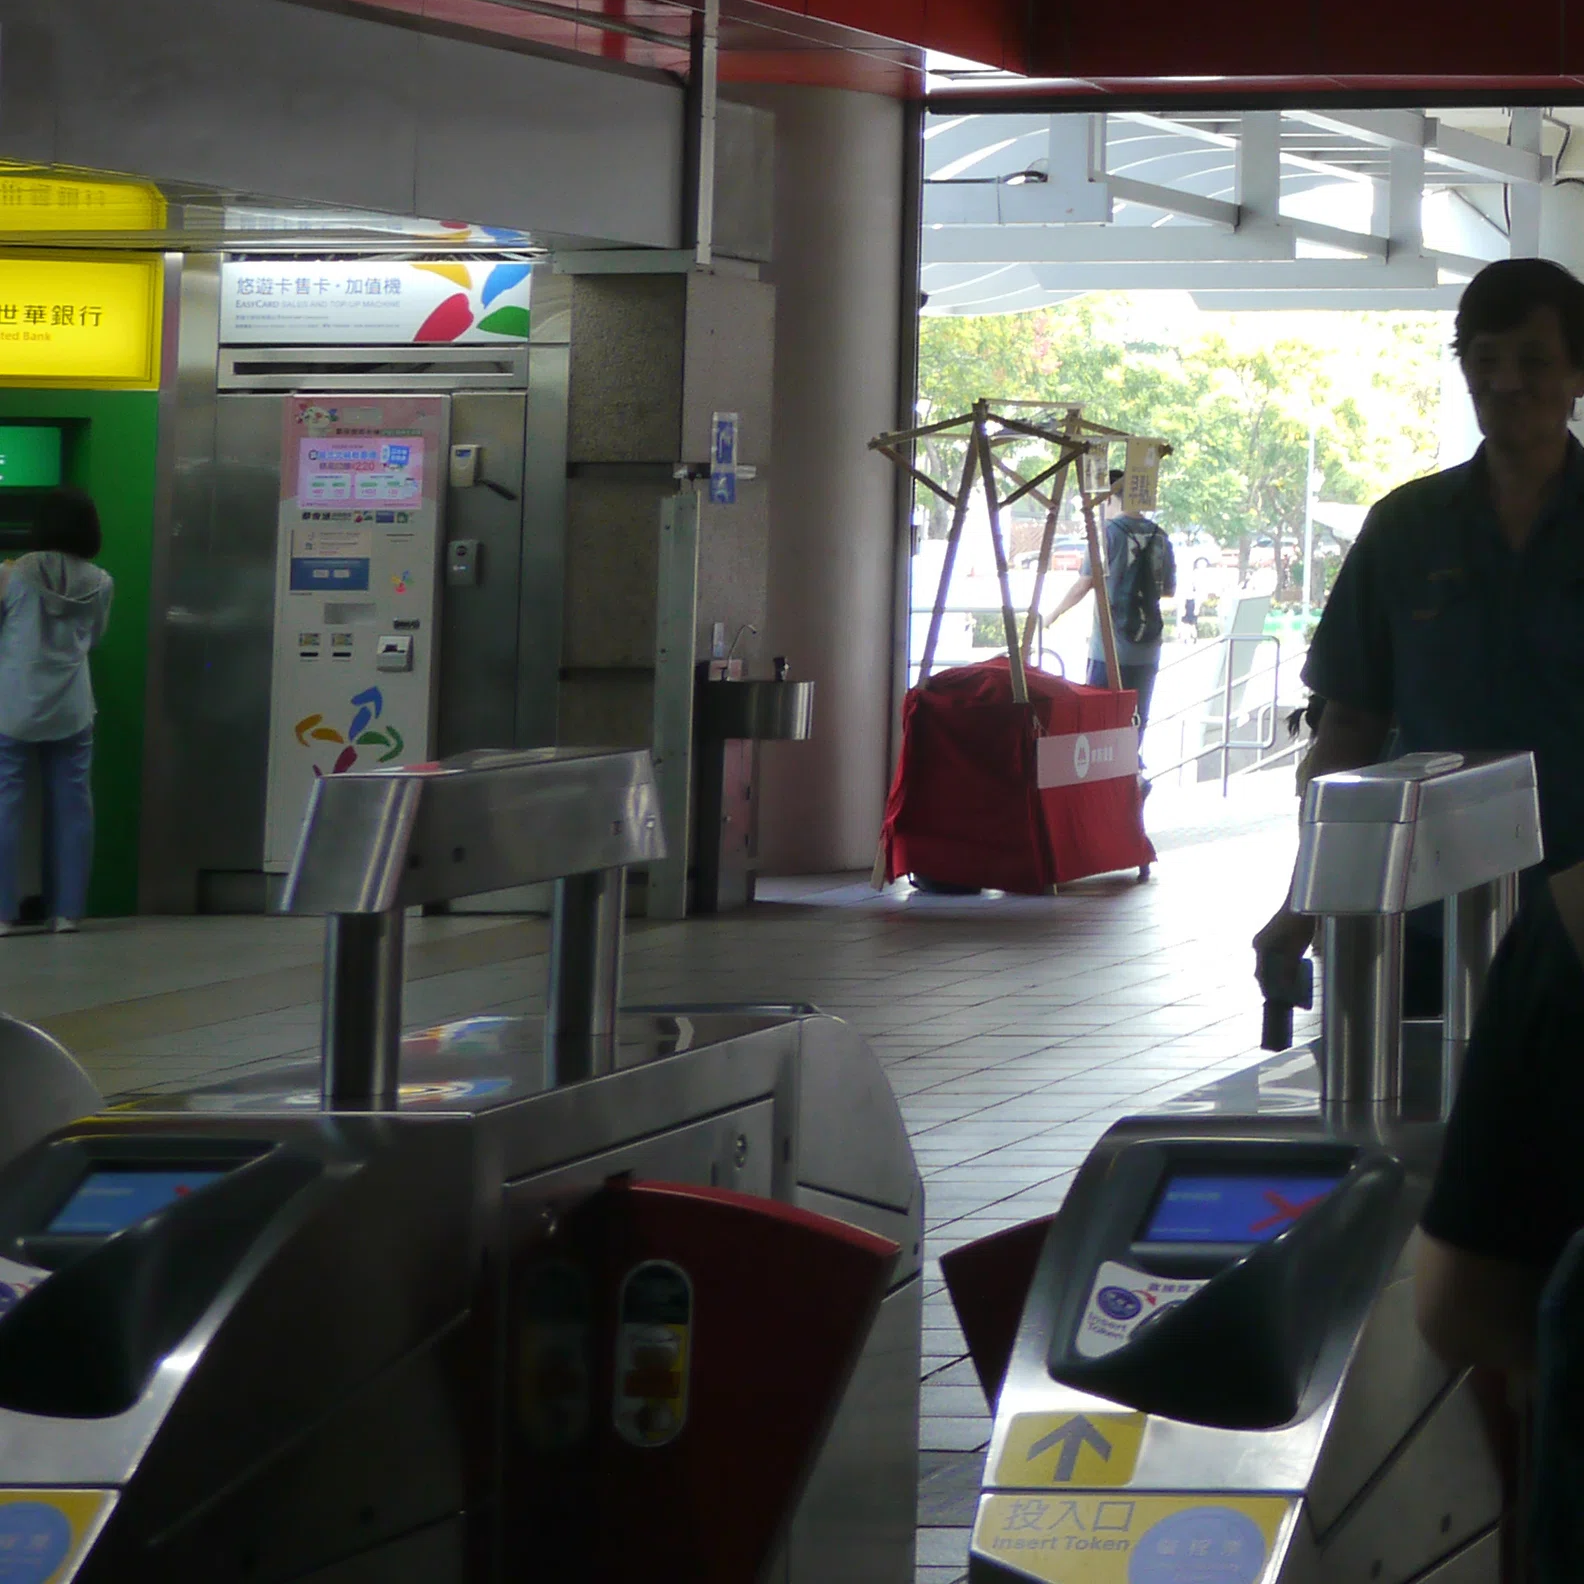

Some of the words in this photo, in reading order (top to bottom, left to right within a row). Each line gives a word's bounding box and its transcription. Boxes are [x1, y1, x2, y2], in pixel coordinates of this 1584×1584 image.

[0, 304, 103, 327] 世華銀行
[23, 331, 51, 341] Bank
[1002, 1498, 1136, 1532] 投入口
[991, 1535, 1060, 1552] Insert
[1064, 1535, 1131, 1552] Token
